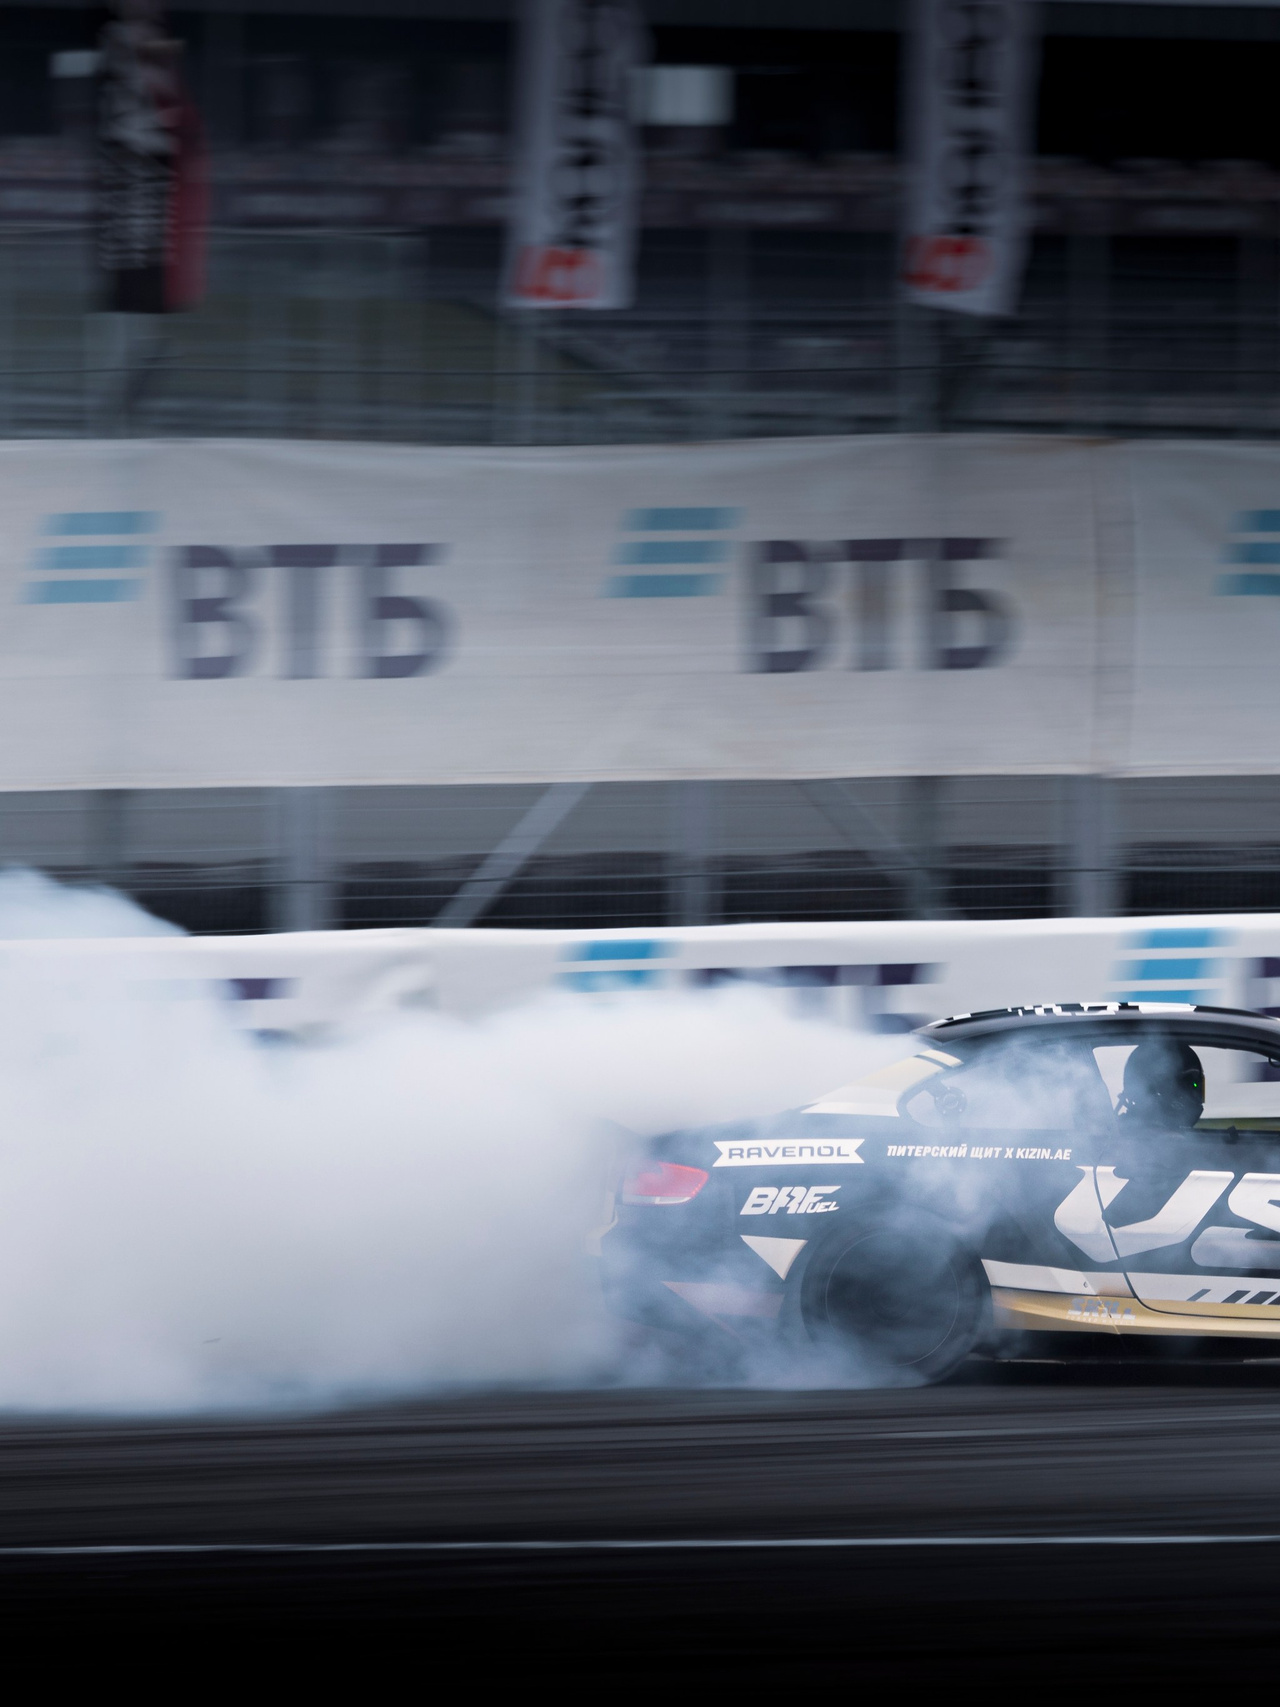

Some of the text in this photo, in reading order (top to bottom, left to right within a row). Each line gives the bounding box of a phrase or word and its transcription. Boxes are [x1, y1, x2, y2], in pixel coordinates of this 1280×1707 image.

[166, 543, 456, 681] ВТБ
[744, 538, 1018, 673] ВТБ
[728, 1145, 850, 1159] RAVENOL
[887, 1143, 967, 1158] ПИТЕРСКИЙ
[970, 1147, 1002, 1159] ЩИТ
[1016, 1148, 1072, 1160] KIZIN.AE
